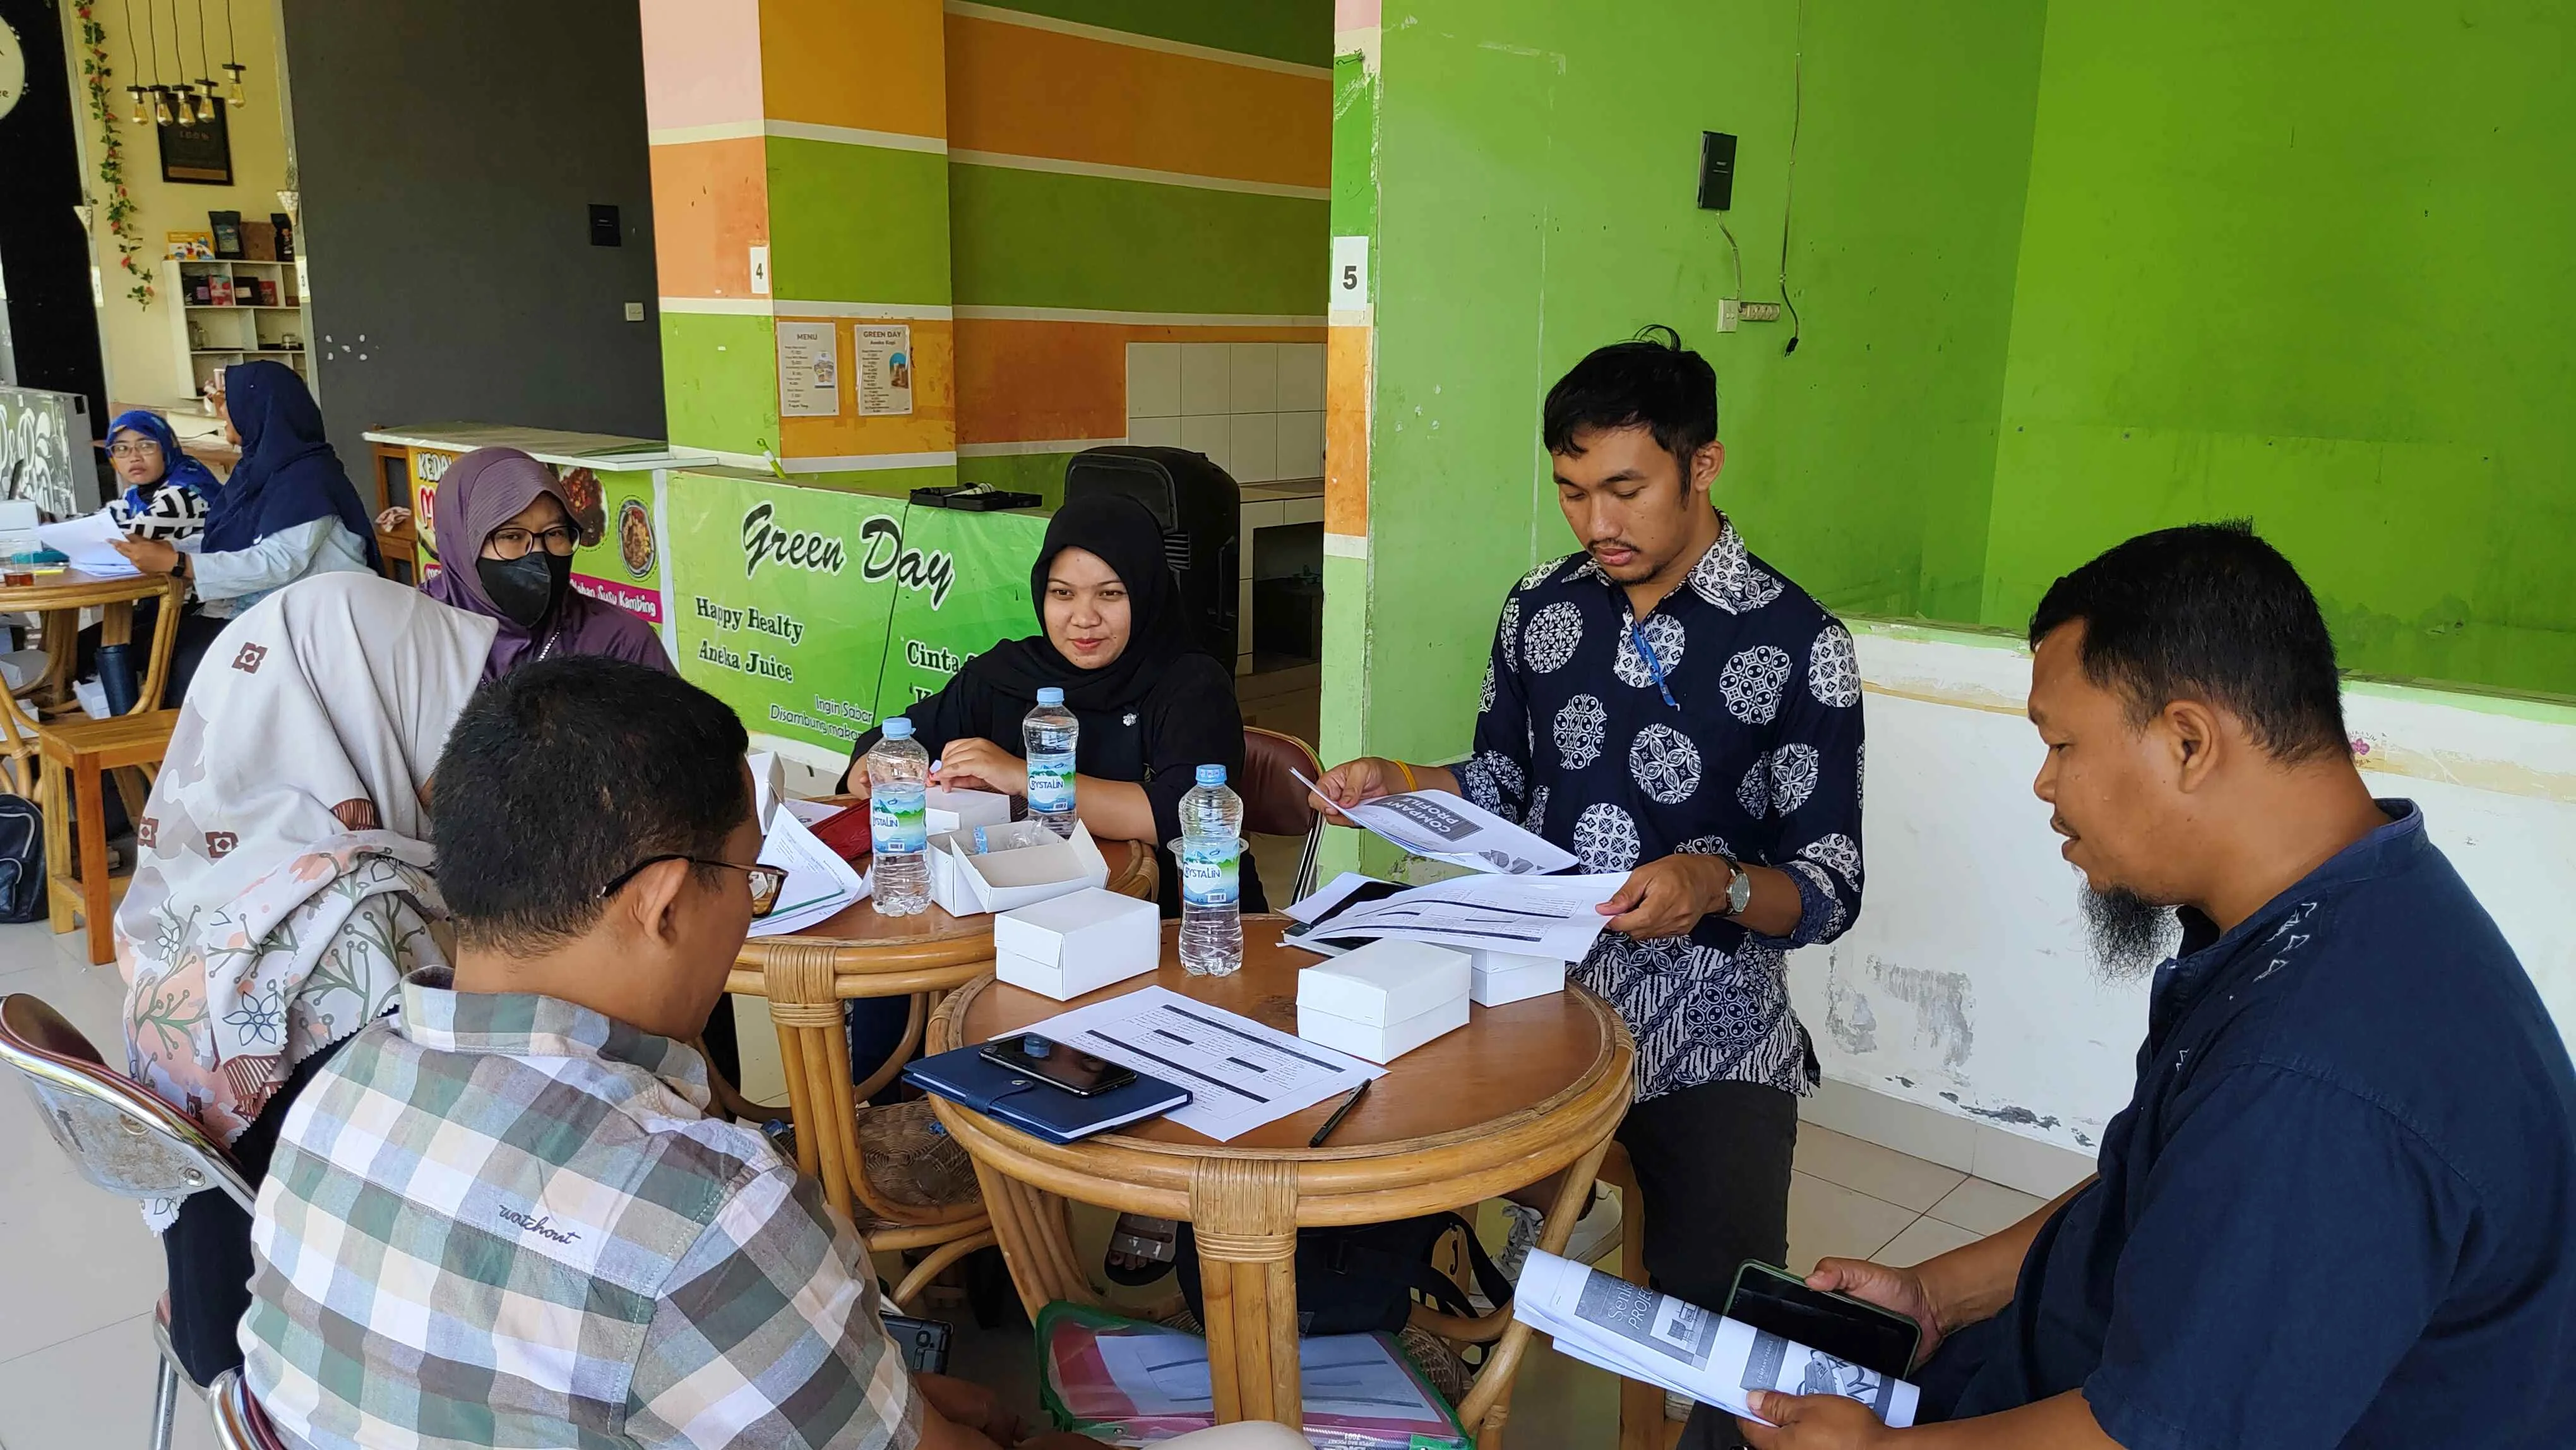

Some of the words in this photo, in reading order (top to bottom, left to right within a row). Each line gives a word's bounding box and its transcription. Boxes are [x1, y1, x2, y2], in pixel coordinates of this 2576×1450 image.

[756, 263, 763, 280] 4
[1343, 265, 1357, 290] 5
[417, 453, 453, 482] KEDA
[743, 503, 845, 577] Green
[861, 517, 955, 608] Day
[598, 585, 617, 605] Susu
[619, 590, 656, 617] Kambing
[696, 597, 742, 630] Happy
[748, 608, 803, 644] Healty
[699, 640, 740, 669] Aneka
[746, 652, 792, 681] Juice
[907, 642, 960, 673] Cinta
[770, 704, 827, 734] Disambung
[815, 695, 840, 715] Ingin
[1383, 801, 1451, 833] COMPANY
[1400, 798, 1459, 825] PROFILE
[499, 1204, 581, 1245] watchout
[1628, 1286, 1653, 1330] PROJEC
